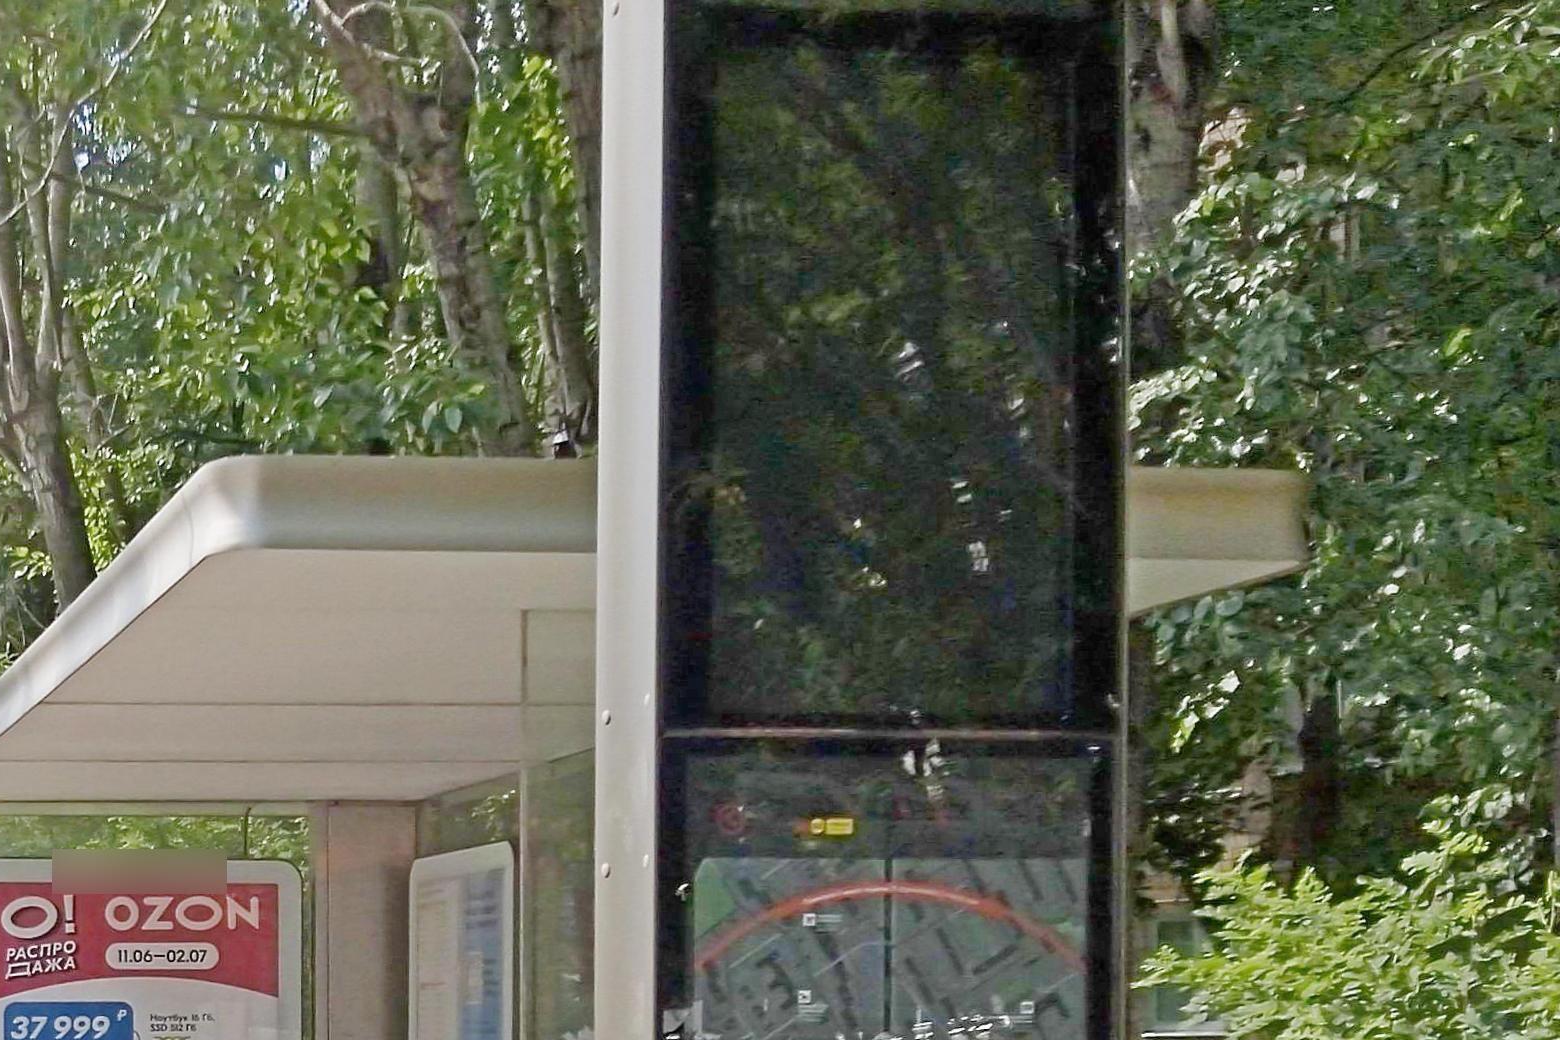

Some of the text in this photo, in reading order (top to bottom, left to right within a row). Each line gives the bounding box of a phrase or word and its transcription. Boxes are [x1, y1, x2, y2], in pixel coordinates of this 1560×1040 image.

[104, 895, 260, 931] OZON
[6, 940, 77, 962] РАСПРО
[5, 956, 76, 980] ДАЖА
[10, 1015, 48, 1040] 37
[53, 1015, 111, 1040] 999
[149, 1013, 188, 1023] Ноутбук
[150, 1023, 168, 1032] SSD
